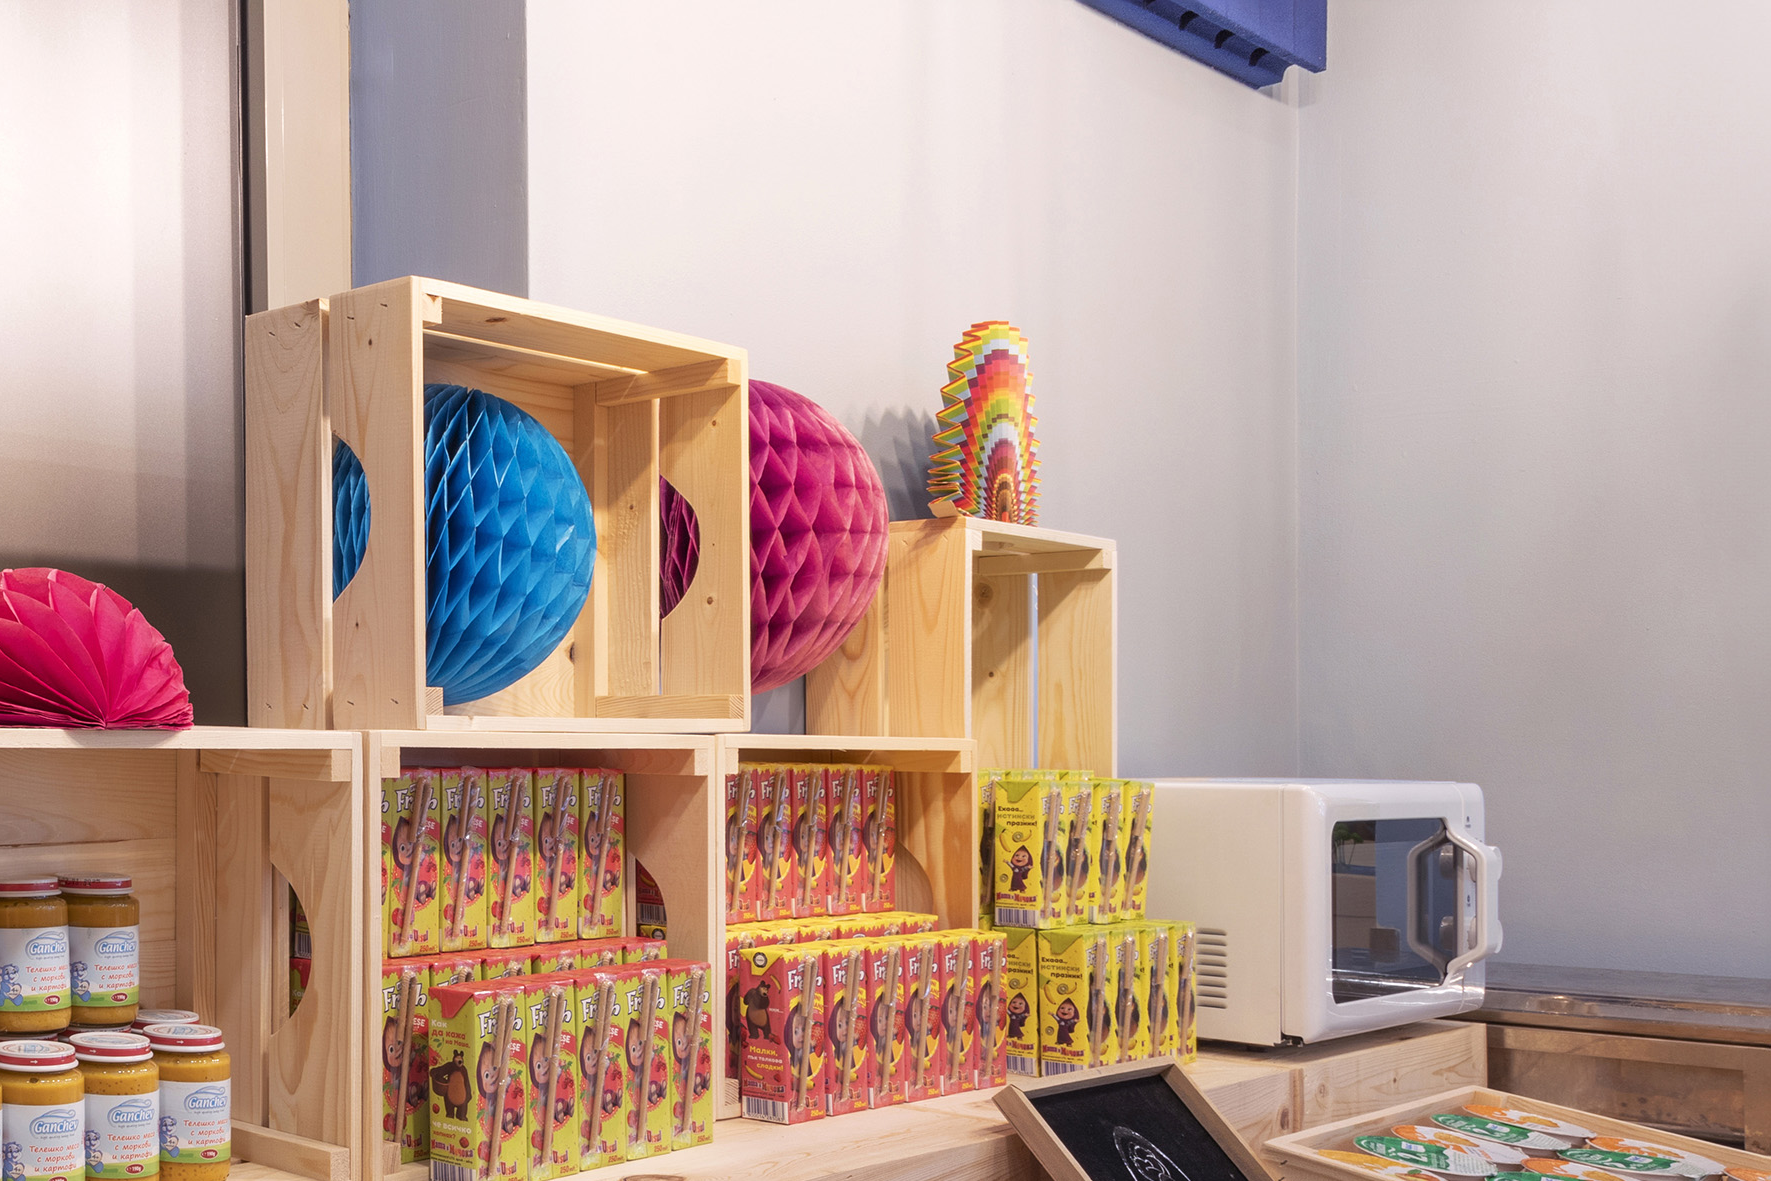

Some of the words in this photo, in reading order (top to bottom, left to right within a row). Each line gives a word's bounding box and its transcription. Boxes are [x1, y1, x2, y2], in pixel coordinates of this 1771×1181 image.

[431, 1019, 448, 1028] Как
[431, 1029, 443, 1038] да
[445, 1030, 466, 1040] кажа
[442, 1122, 472, 1134] всичко
[106, 1133, 140, 1142] Телешко
[29, 1144, 64, 1153] Телешко
